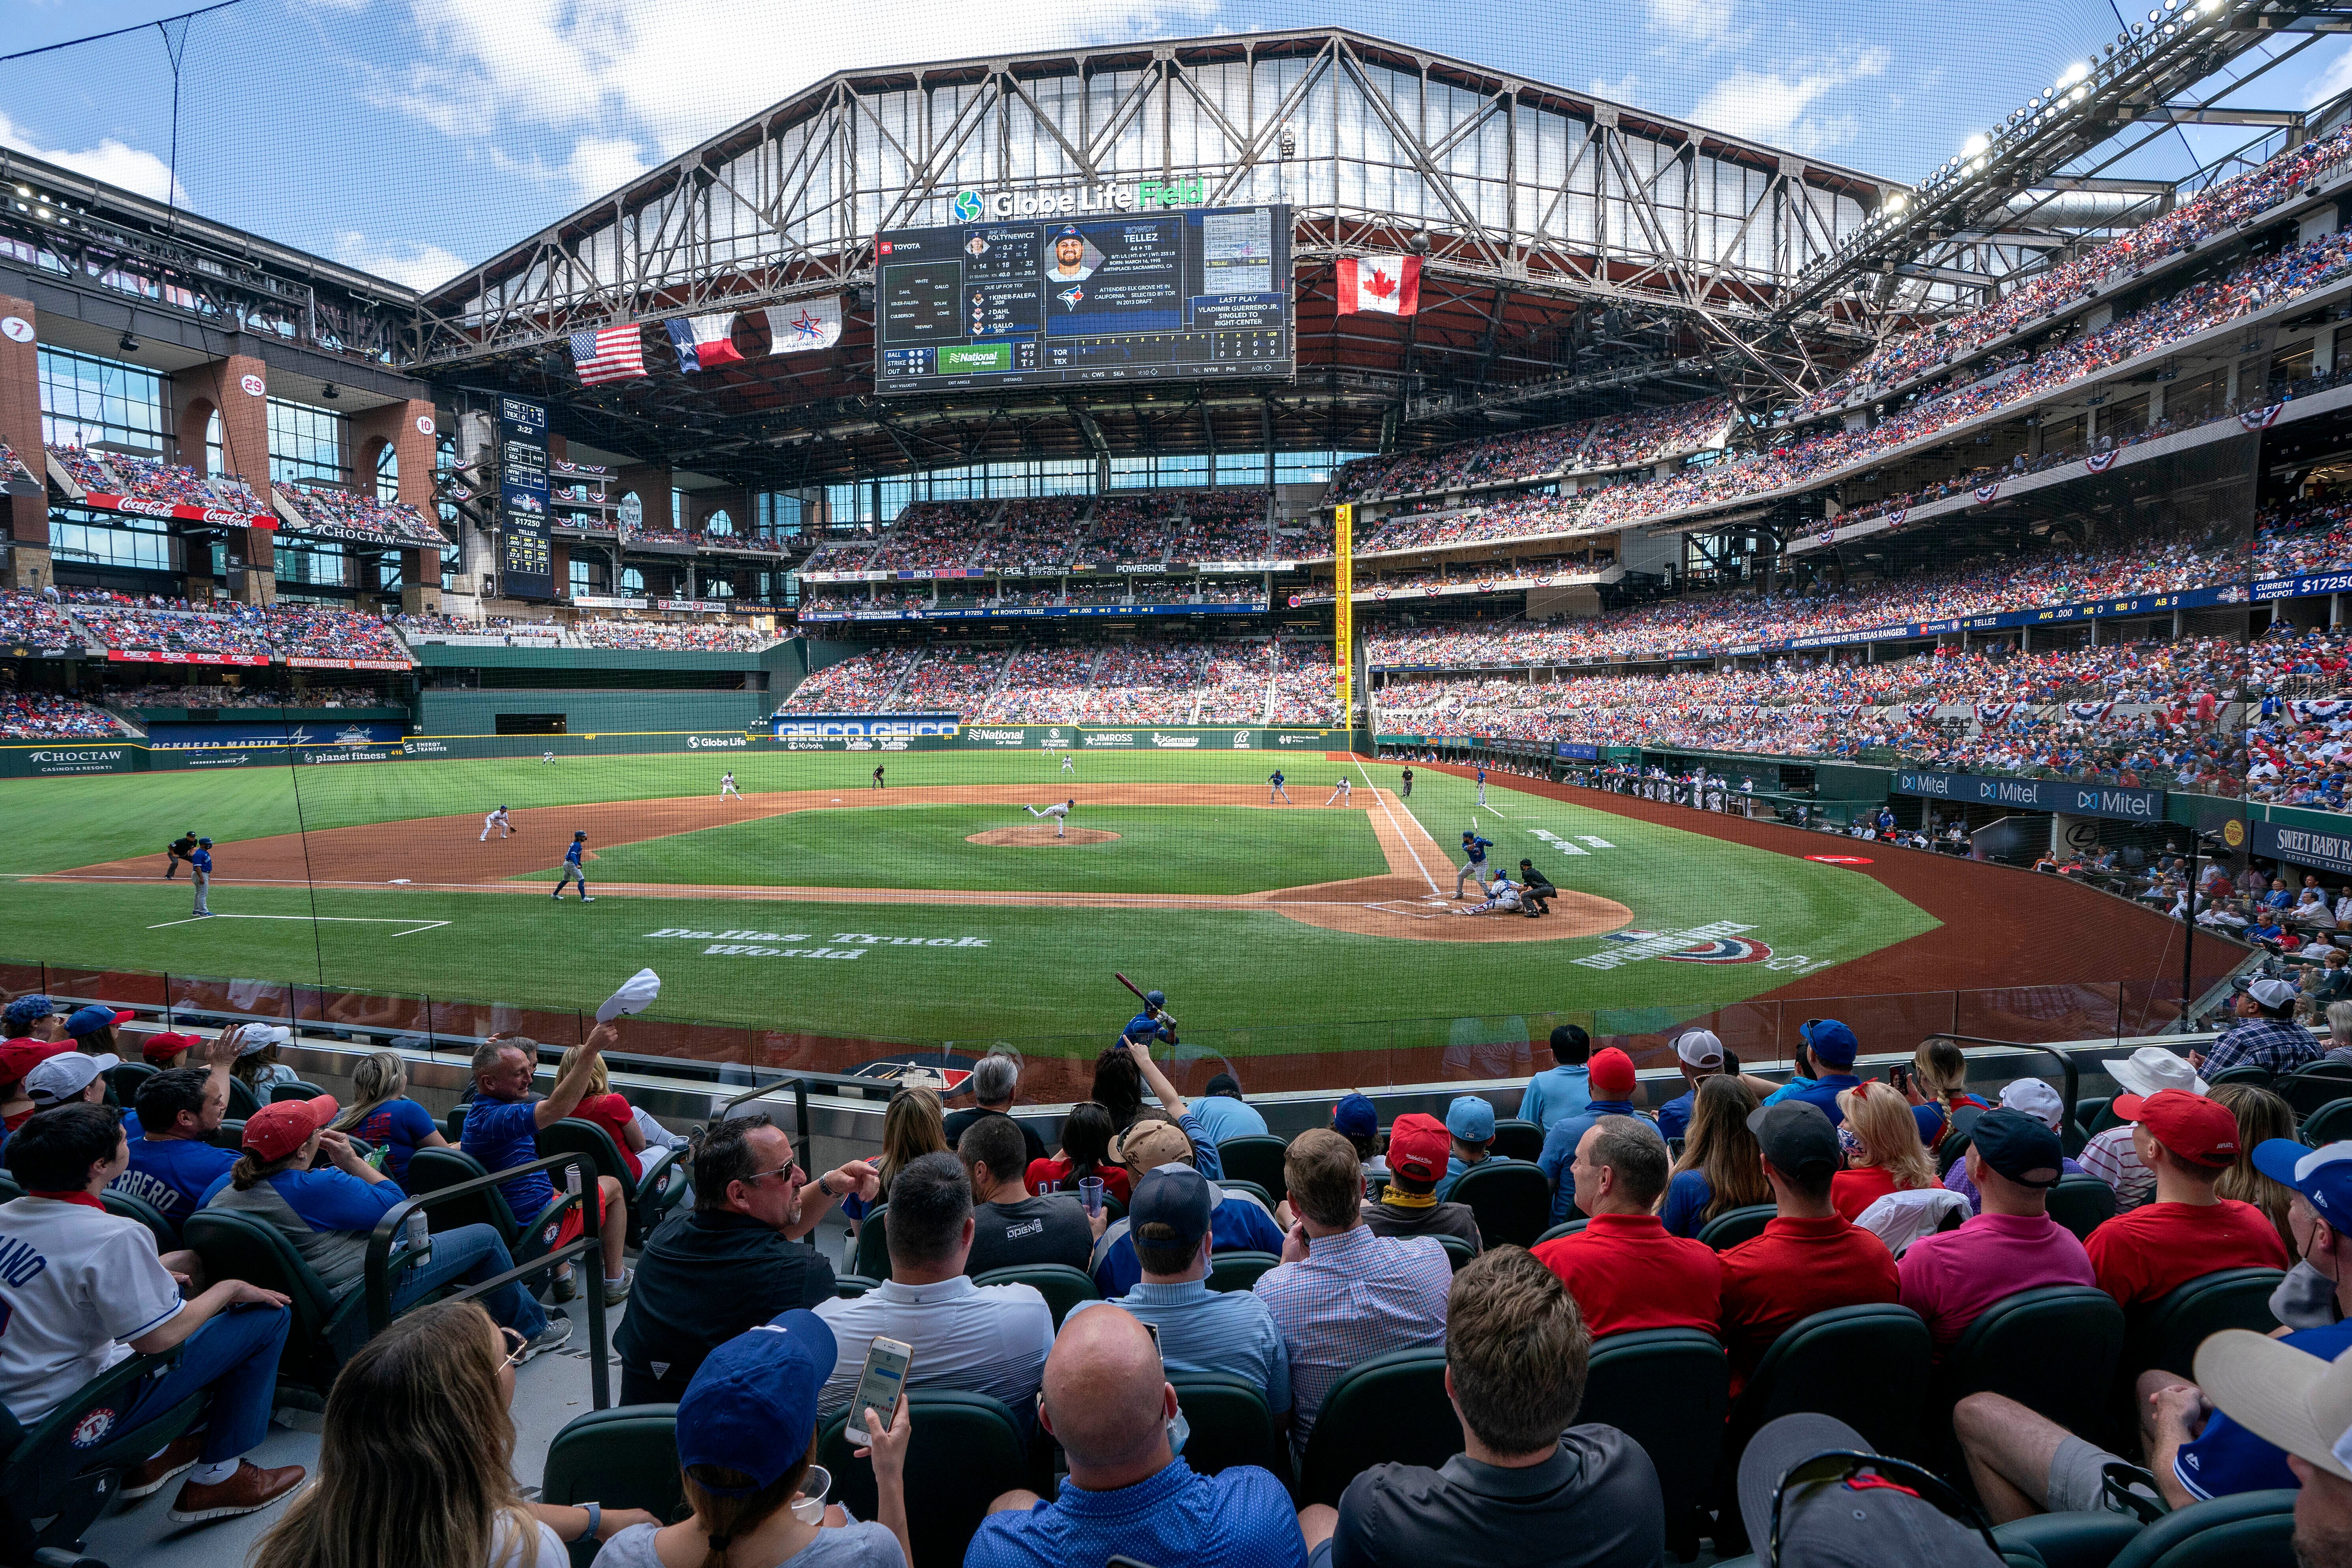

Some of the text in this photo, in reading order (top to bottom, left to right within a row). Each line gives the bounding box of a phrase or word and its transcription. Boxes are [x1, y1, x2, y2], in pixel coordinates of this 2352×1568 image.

[992, 176, 1203, 217] Globe Life Field
[1125, 225, 1156, 234] ROWDY
[987, 232, 1035, 241] FOLTYNEWICZ
[1123, 233, 1158, 243] TELLEZ
[894, 243, 921, 251] TOYOTA
[992, 292, 1036, 301] KINER-FALEFA
[12, 322, 24, 337] 7
[960, 352, 998, 362] National
[245, 378, 262, 393] 29
[506, 402, 518, 410] TOR
[507, 410, 518, 419] TEX
[420, 419, 431, 431] 10
[517, 425, 533, 434] 3:22
[118, 496, 176, 518] Coca-Cola
[203, 508, 254, 528] Coca-Cola
[515, 517, 540, 528] $17250
[322, 525, 395, 544] CHOCTAW
[518, 529, 537, 537] TELLEZ
[913, 570, 933, 578] 105.3
[1116, 564, 1167, 573] POWERADE
[2255, 580, 2294, 591] CURRENT
[2255, 589, 2294, 600] JACKPOT
[670, 602, 725, 612] QuikTrip QuikTrip
[2056, 609, 2073, 618] .000
[2083, 606, 2094, 615] HR
[2098, 605, 2103, 613] 0
[2115, 603, 2127, 611] RBI
[2131, 601, 2137, 610] 0
[2155, 598, 2167, 606] AB
[2172, 596, 2178, 605] 8
[1974, 617, 1996, 627] TELLEZ
[1800, 638, 1819, 647] OFFICIAL
[1820, 635, 1841, 644] VEHICLE
[1849, 632, 1860, 641] THE
[1860, 631, 1878, 640] TEXAS
[1878, 627, 1907, 638] RANGERS
[1729, 644, 1759, 655] TOYOTA RAV4
[290, 658, 409, 669] WHATABURGER WHATABURGER
[778, 722, 959, 741] GEICO GEICO
[981, 730, 1025, 740] National
[702, 737, 747, 747] Globe Life
[1095, 733, 1133, 742] JIMROSS
[39, 751, 122, 762] CHOCTAW
[316, 752, 386, 764] planet fitness
[1918, 775, 1948, 795] Mitel
[1999, 782, 2038, 804] Mitel
[2102, 791, 2151, 816] Mitel
[2277, 829, 2311, 852] SWEET
[2311, 834, 2341, 858] BABY
[2286, 853, 2321, 865] GOURMET
[643, 928, 992, 947] Dallas Truck
[703, 944, 869, 960] World
[408, 1229, 428, 1239] ULTRA
[1007, 1224, 1036, 1238] OPEN
[547, 1268, 551, 1277] 2
[98, 1479, 107, 1493] 4
